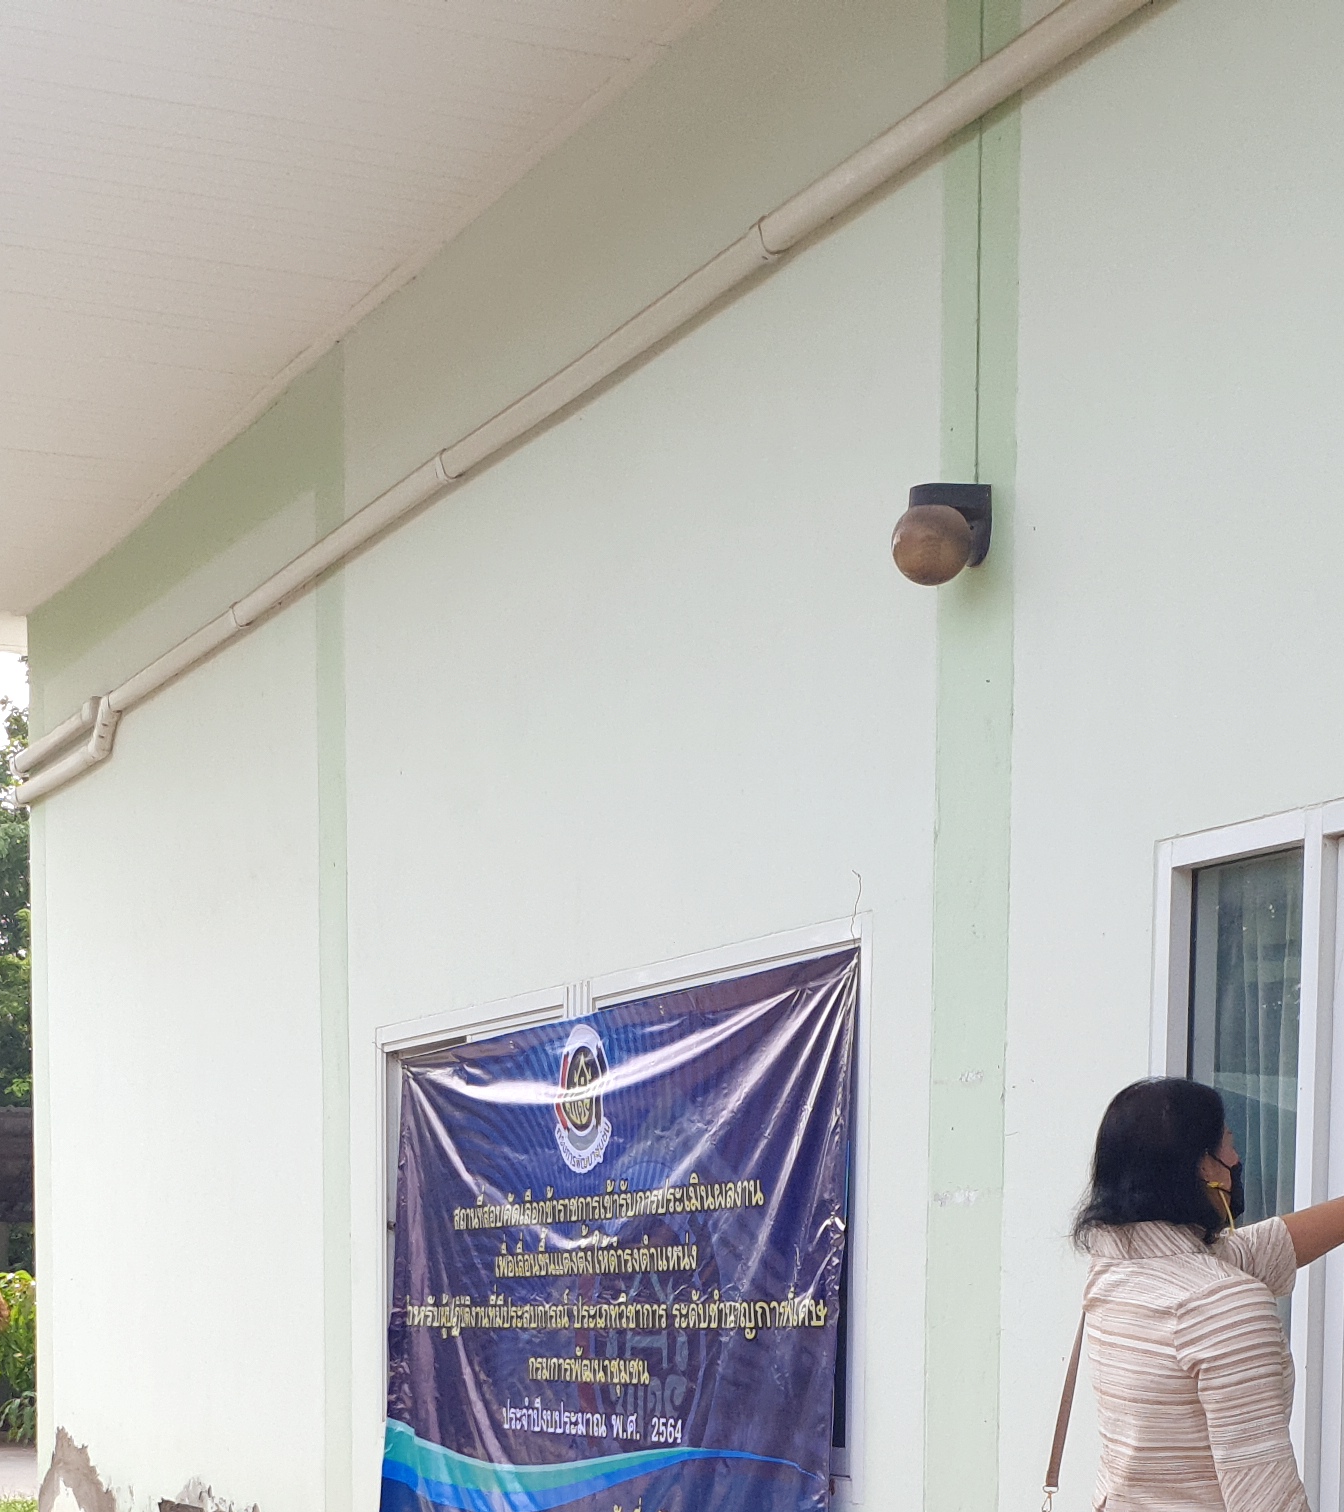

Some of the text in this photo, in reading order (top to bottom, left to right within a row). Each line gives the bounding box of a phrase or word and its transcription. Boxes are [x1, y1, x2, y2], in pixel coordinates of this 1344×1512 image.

[573, 1292, 667, 1329] ประเภทวิชาการ
[528, 1346, 650, 1397] กรมการพัฒนาชุมชน
[502, 1396, 683, 1444] ประจำปีงบประมาณ พ.ศ. 2564
